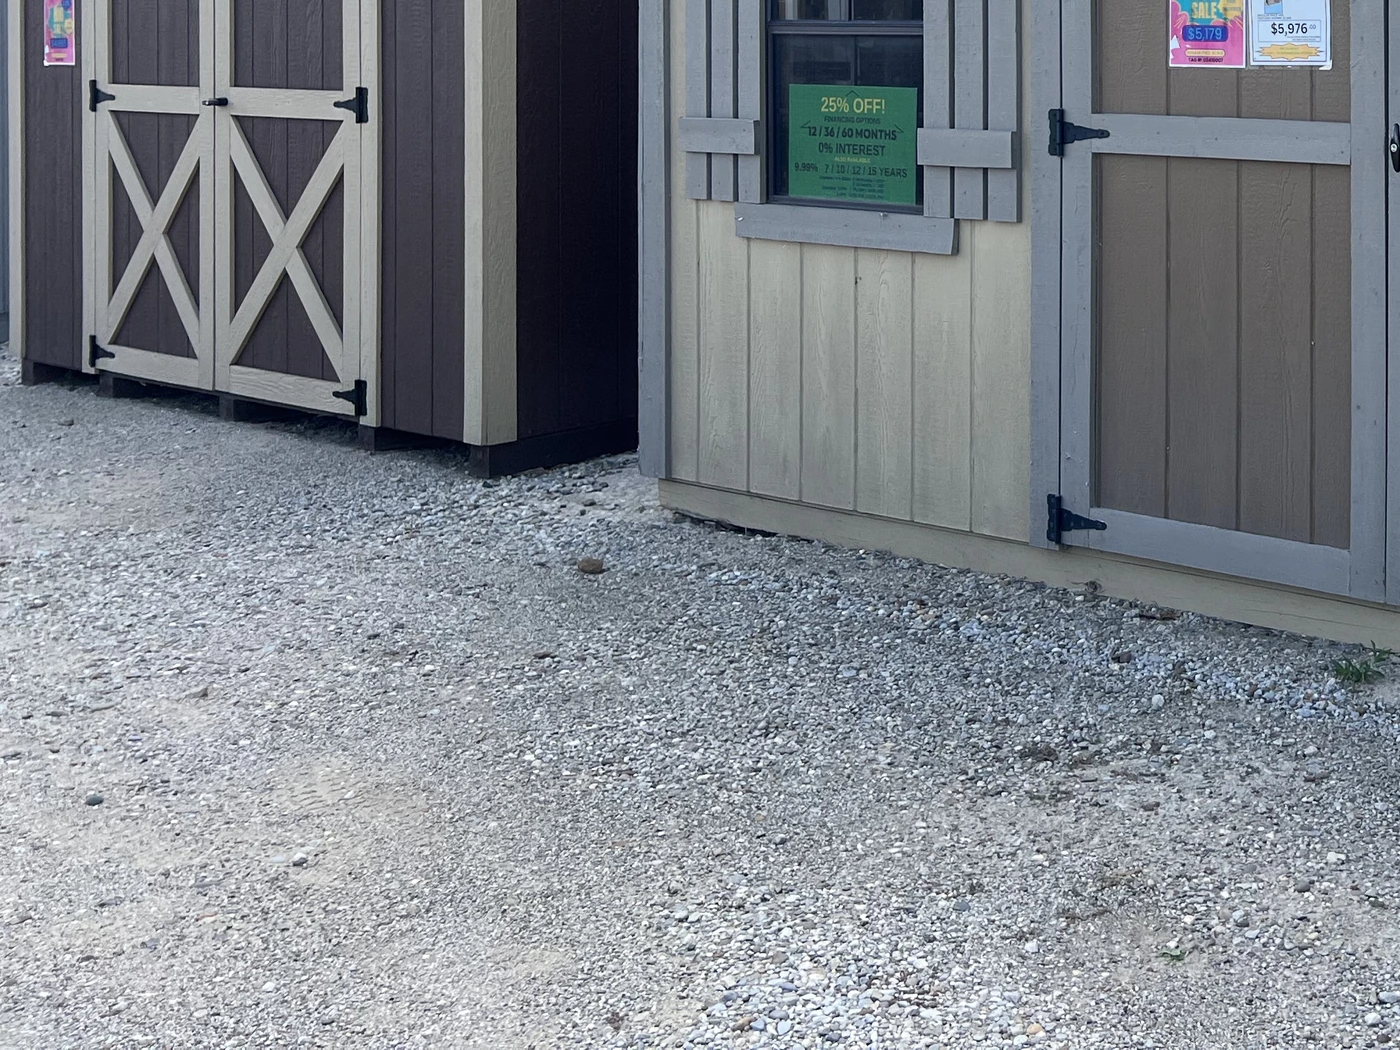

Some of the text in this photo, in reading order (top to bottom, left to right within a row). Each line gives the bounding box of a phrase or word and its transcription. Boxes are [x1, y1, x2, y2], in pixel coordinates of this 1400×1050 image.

[1192, 1, 1217, 19] SALE
[1188, 27, 1222, 41] $5,179
[1271, 22, 1308, 36] $5,976
[820, 97, 886, 114] 25% OFF!
[824, 116, 855, 124] FINANCING
[808, 126, 817, 137] 12
[824, 126, 835, 137] 36
[841, 127, 853, 138] 60
[855, 128, 898, 141] MONTHS
[818, 142, 886, 156] 0% INTEREST
[836, 164, 846, 174] 10
[852, 165, 861, 175] 12
[868, 166, 877, 176] 15
[879, 167, 908, 179] YEARS
